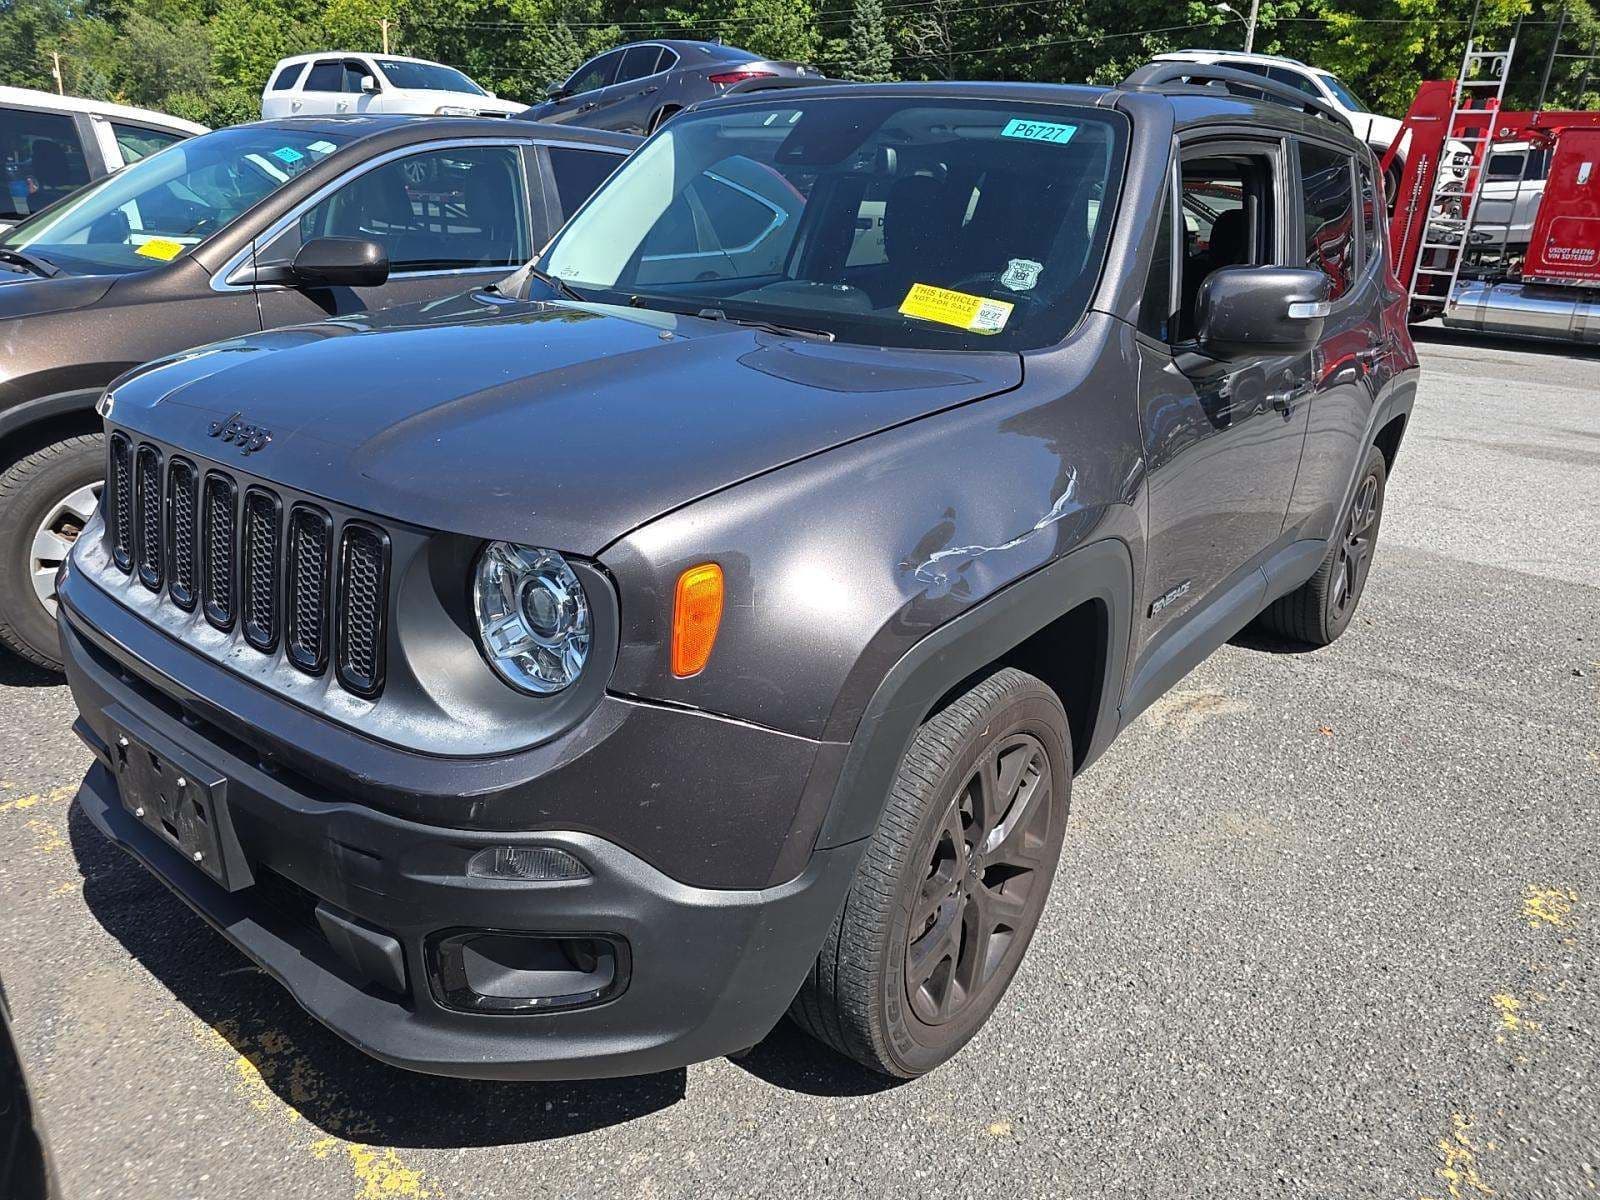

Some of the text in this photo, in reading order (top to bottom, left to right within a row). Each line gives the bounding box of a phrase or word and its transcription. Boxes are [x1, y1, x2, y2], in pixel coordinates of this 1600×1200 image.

[1012, 122, 1067, 140] P6727
[912, 294, 930, 302] NOT
[931, 298, 949, 307] FOR
[950, 302, 974, 313] SALE
[914, 286, 937, 297] THIS
[939, 291, 980, 307] VEHICLE
[207, 411, 272, 456] Jeep
